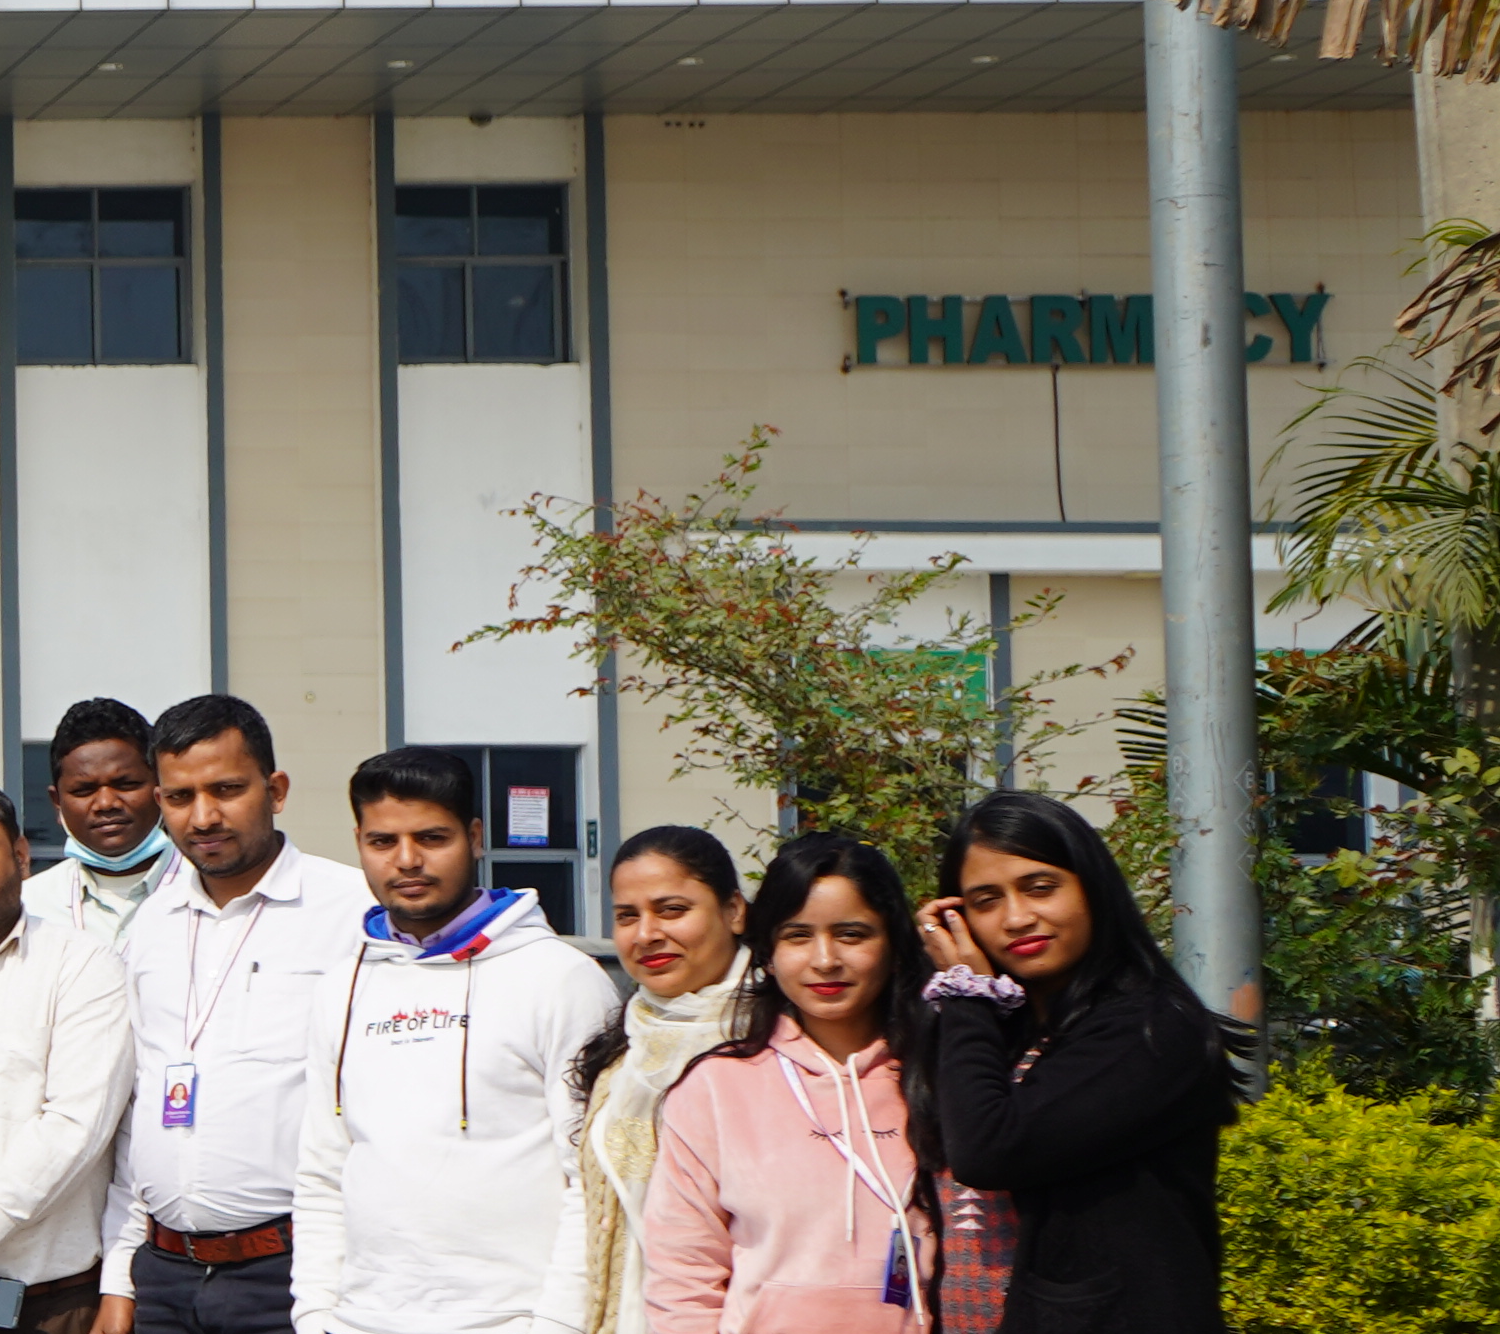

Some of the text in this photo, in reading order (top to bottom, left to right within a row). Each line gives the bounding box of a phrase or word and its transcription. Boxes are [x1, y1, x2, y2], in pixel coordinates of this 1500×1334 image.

[856, 292, 1332, 364] PHARMCY
[366, 1013, 470, 1036] FIRE OF LIFE
